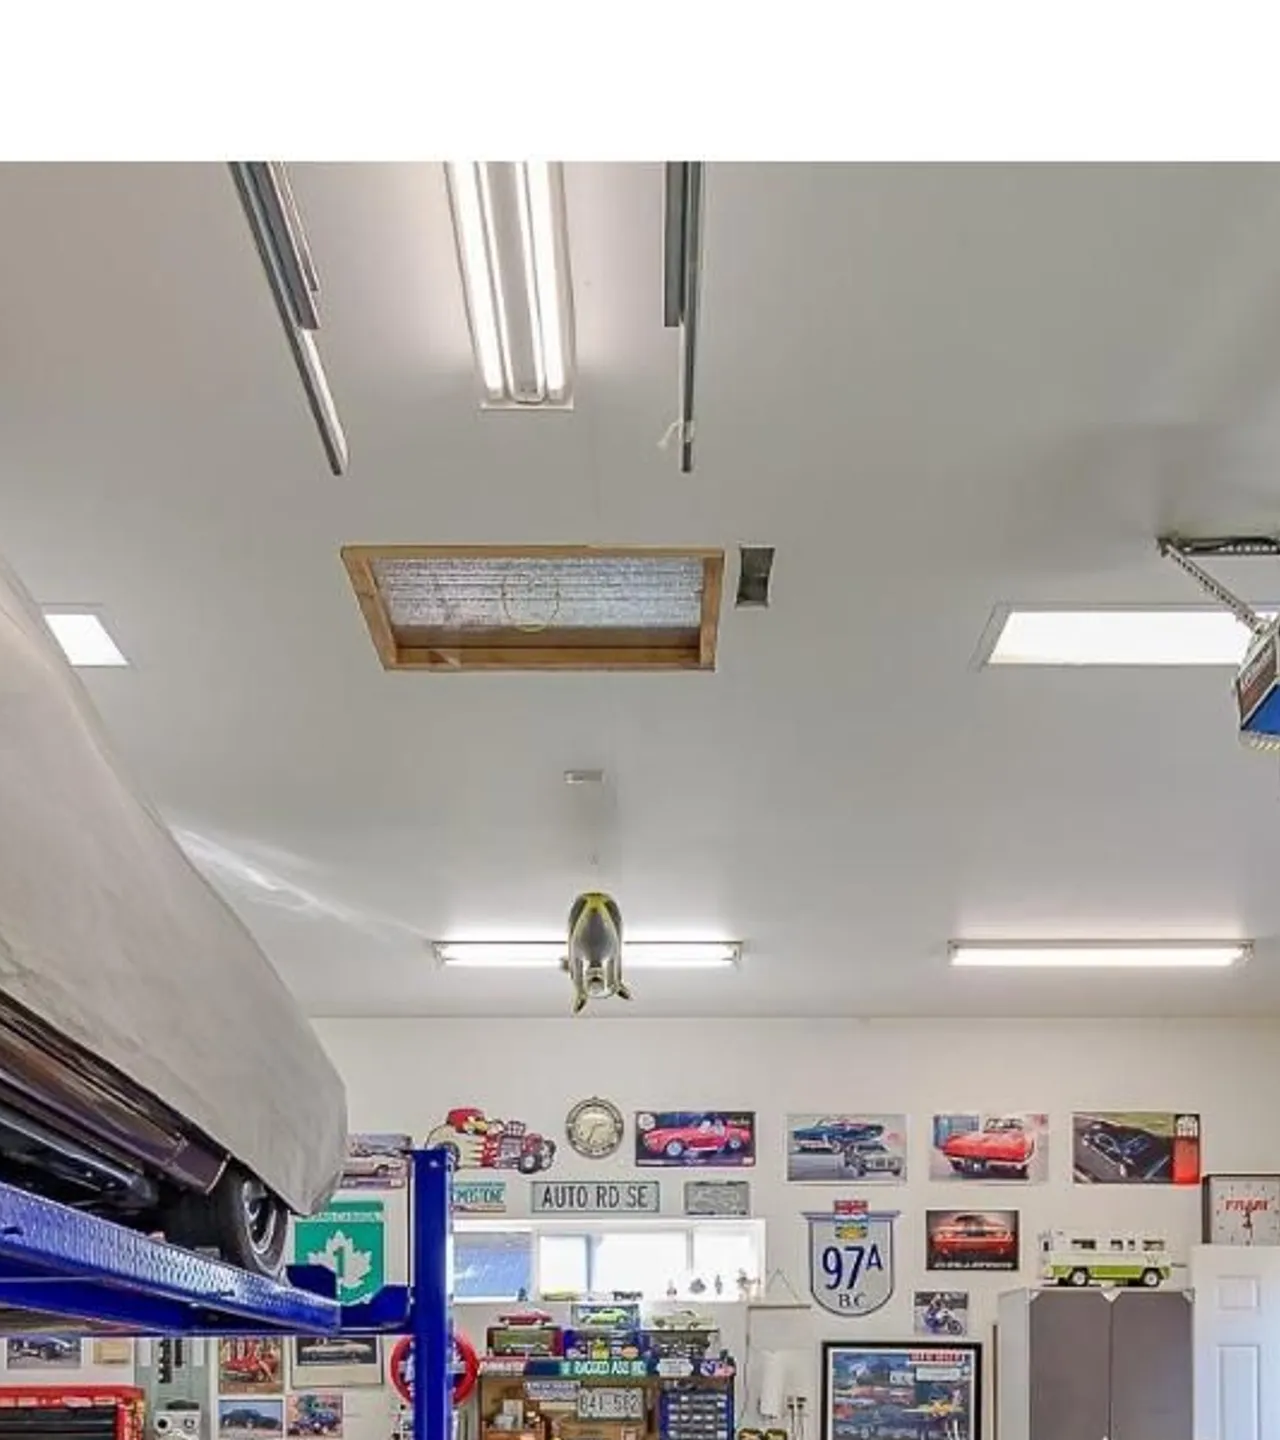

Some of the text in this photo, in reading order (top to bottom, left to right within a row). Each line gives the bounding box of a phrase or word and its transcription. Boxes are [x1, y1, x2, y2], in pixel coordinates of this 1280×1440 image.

[541, 1185, 649, 1208] AUTO RD SE
